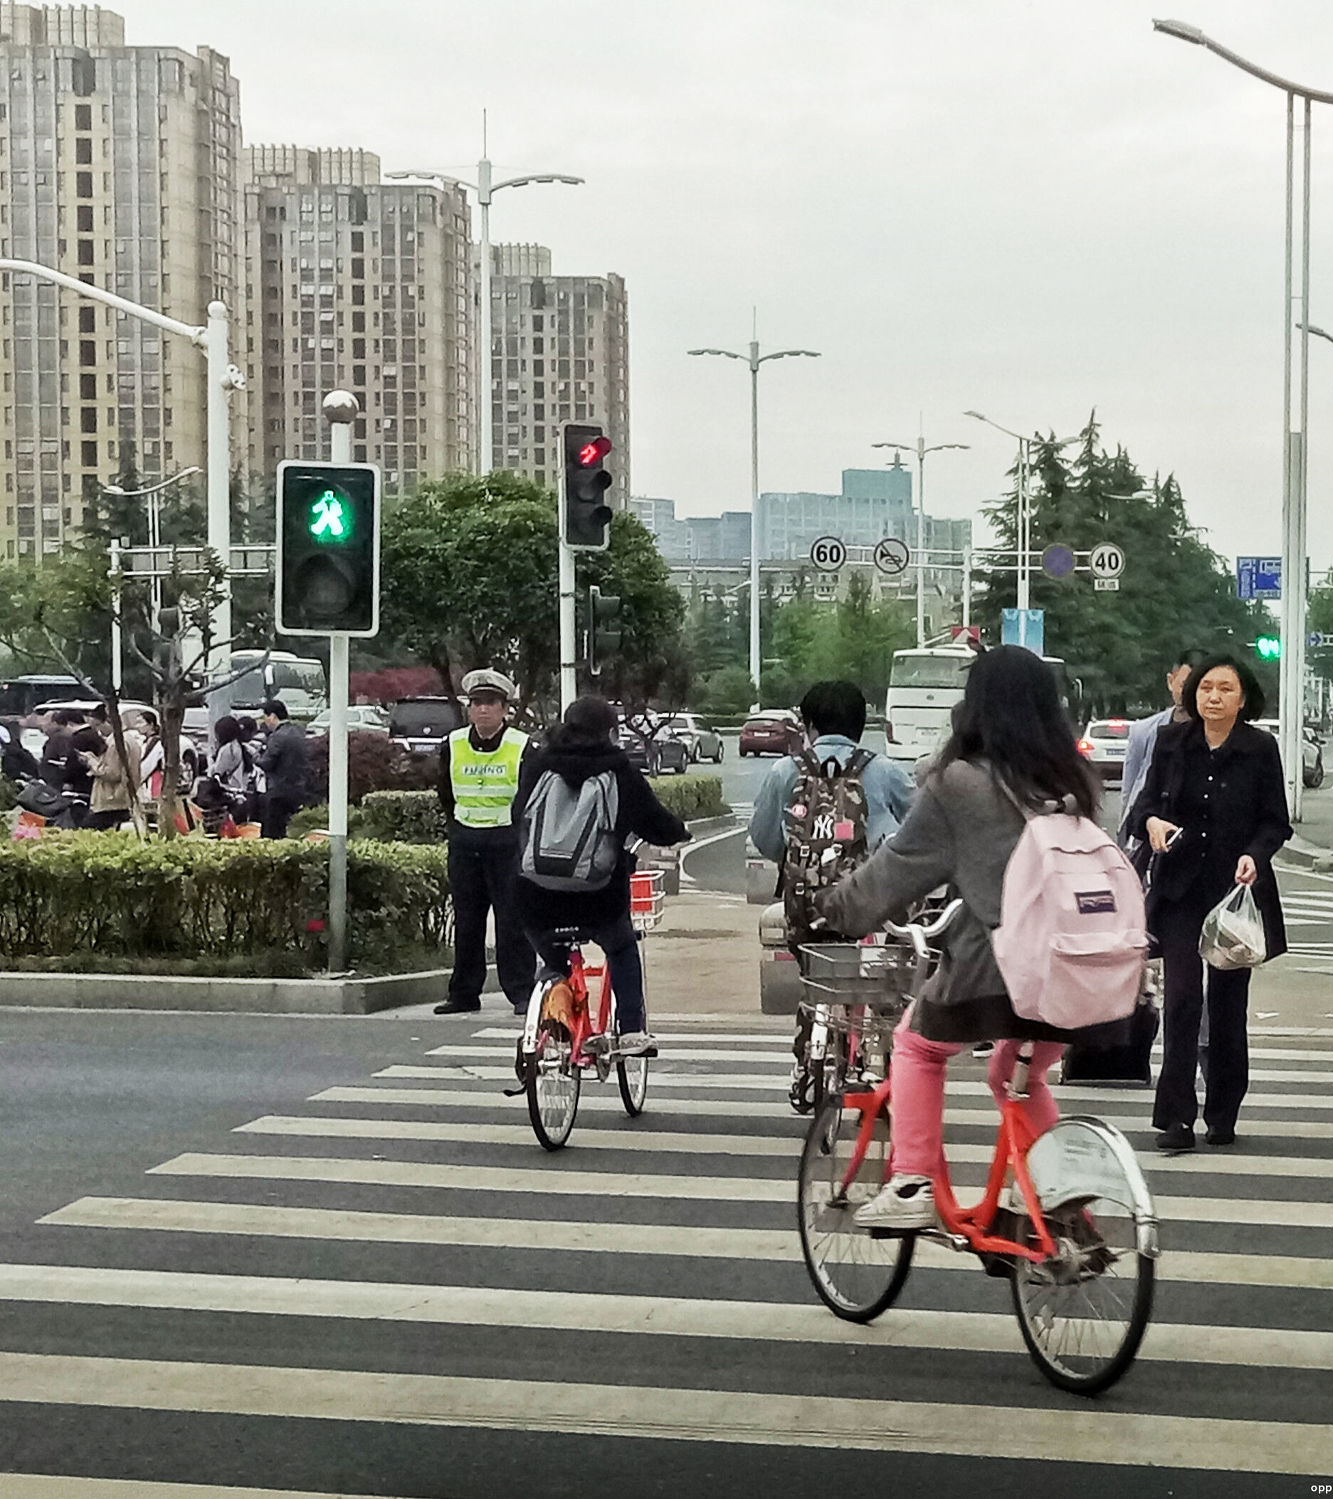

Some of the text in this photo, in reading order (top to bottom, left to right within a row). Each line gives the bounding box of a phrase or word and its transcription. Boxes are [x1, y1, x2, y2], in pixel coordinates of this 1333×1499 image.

[816, 544, 840, 563] 60
[1095, 552, 1119, 570] 40
[811, 814, 834, 840] NY
